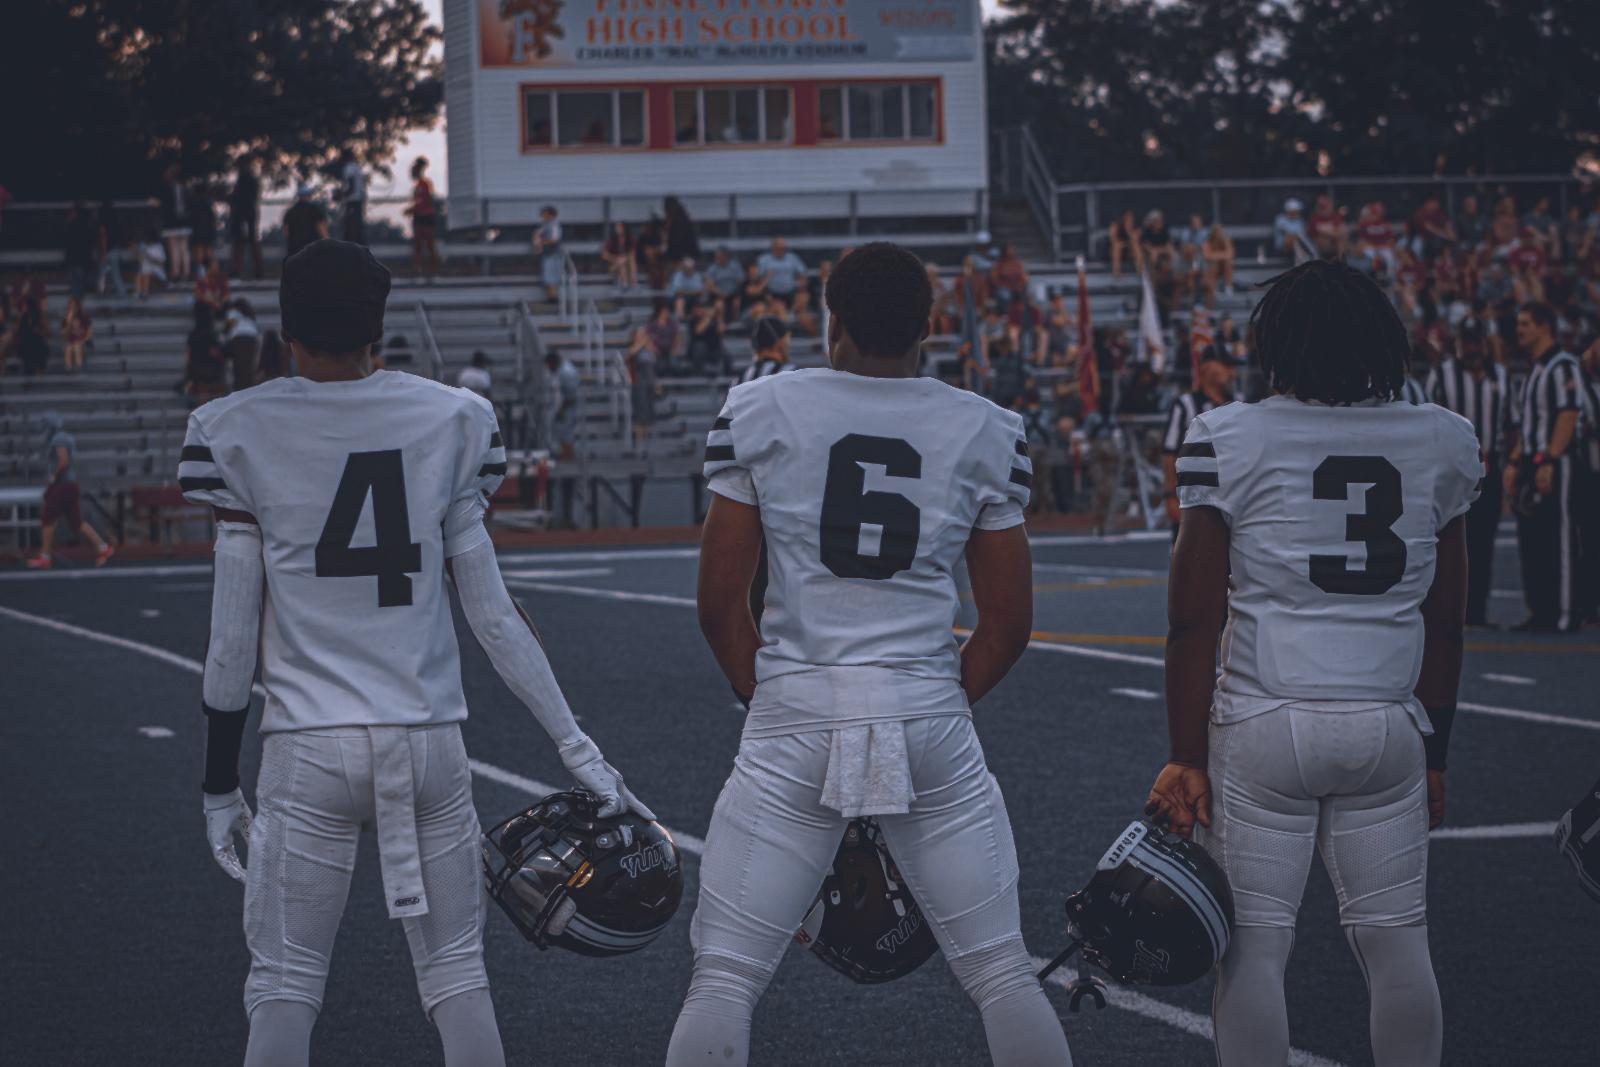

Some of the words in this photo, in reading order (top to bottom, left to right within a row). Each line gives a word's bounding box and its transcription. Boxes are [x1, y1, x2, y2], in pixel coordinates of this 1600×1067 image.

[585, 15, 684, 45] HIGH
[697, 13, 858, 43] SCHOOL
[315, 449, 421, 607] 4
[820, 433, 921, 580] 6
[1309, 455, 1407, 595] 3
